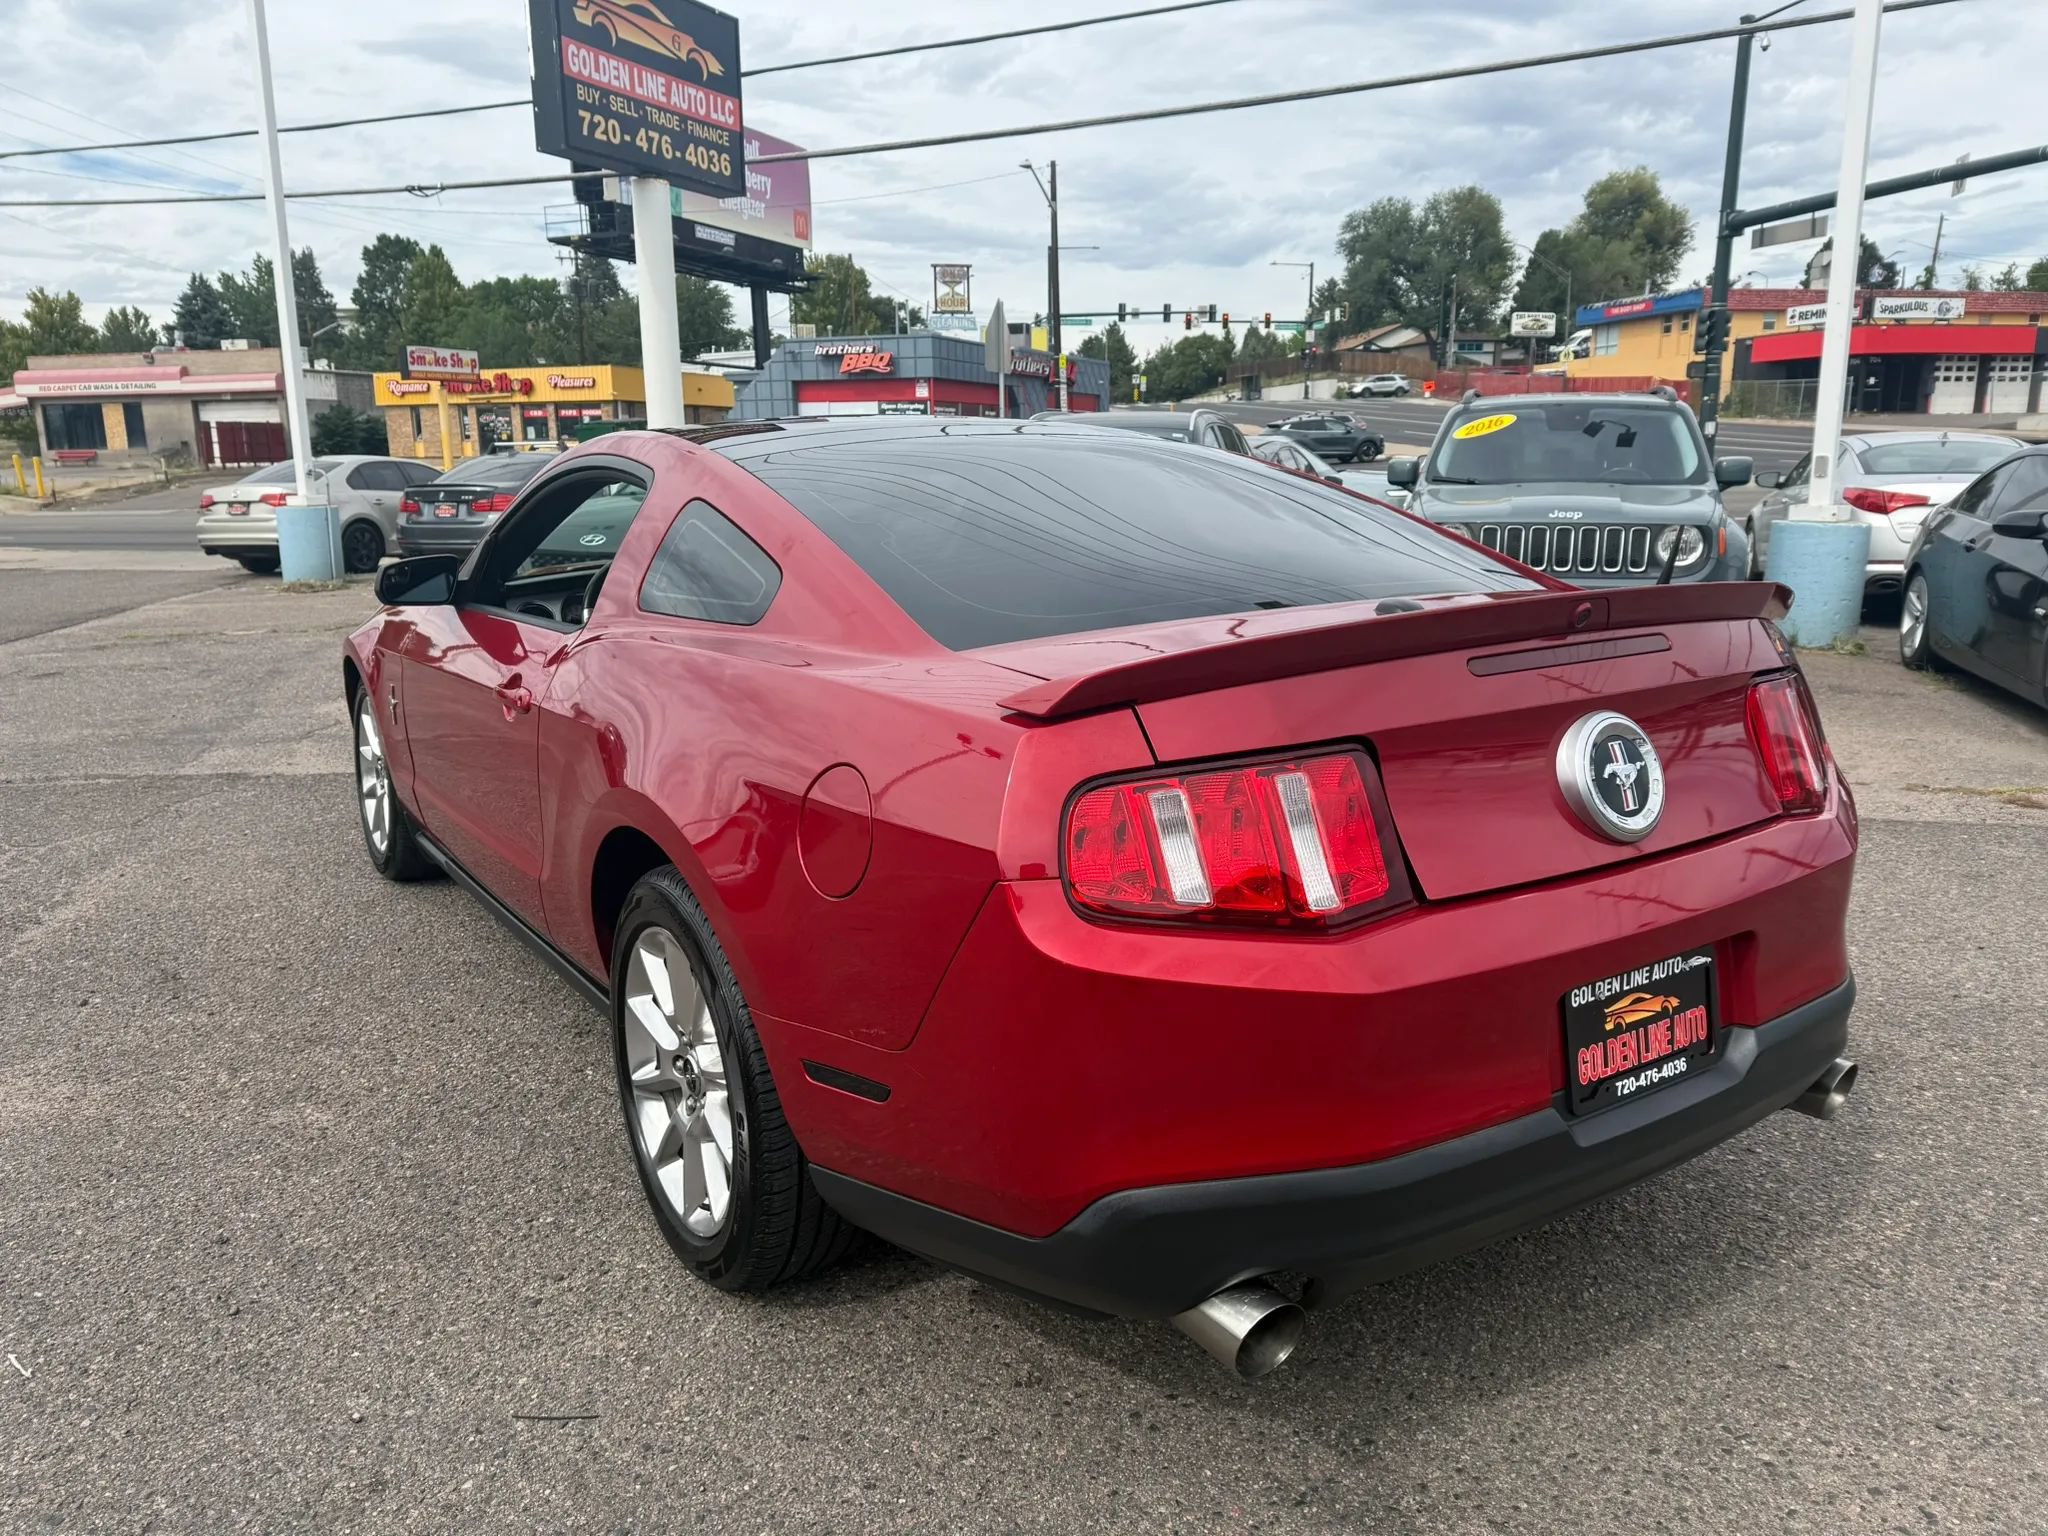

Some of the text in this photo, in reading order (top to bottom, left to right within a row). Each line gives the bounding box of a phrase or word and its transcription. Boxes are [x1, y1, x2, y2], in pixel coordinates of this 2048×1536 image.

[568, 44, 734, 125] GOLDEN LINE AUTO LLC
[576, 83, 730, 146] BUY SELL TRADE FINANCE
[940, 297, 966, 308] HOUR
[1879, 300, 1928, 315] SPARKULOUS
[814, 343, 874, 355] brothers
[840, 352, 893, 373] BBQ
[1011, 357, 1051, 375] rothers
[93, 383, 113, 391] WASH
[120, 382, 157, 391] DETAILING
[387, 380, 430, 397] Romance
[493, 372, 532, 396] Shop
[548, 374, 594, 388] Pleasures
[1464, 416, 1505, 437] 2016
[1548, 509, 1583, 520] Jeep
[1571, 956, 1683, 1008] GOLDEN LINE AUTO
[1577, 1004, 1708, 1086] GOLDEN LINE AUTO
[1615, 1057, 1688, 1097] 720-476-4036
